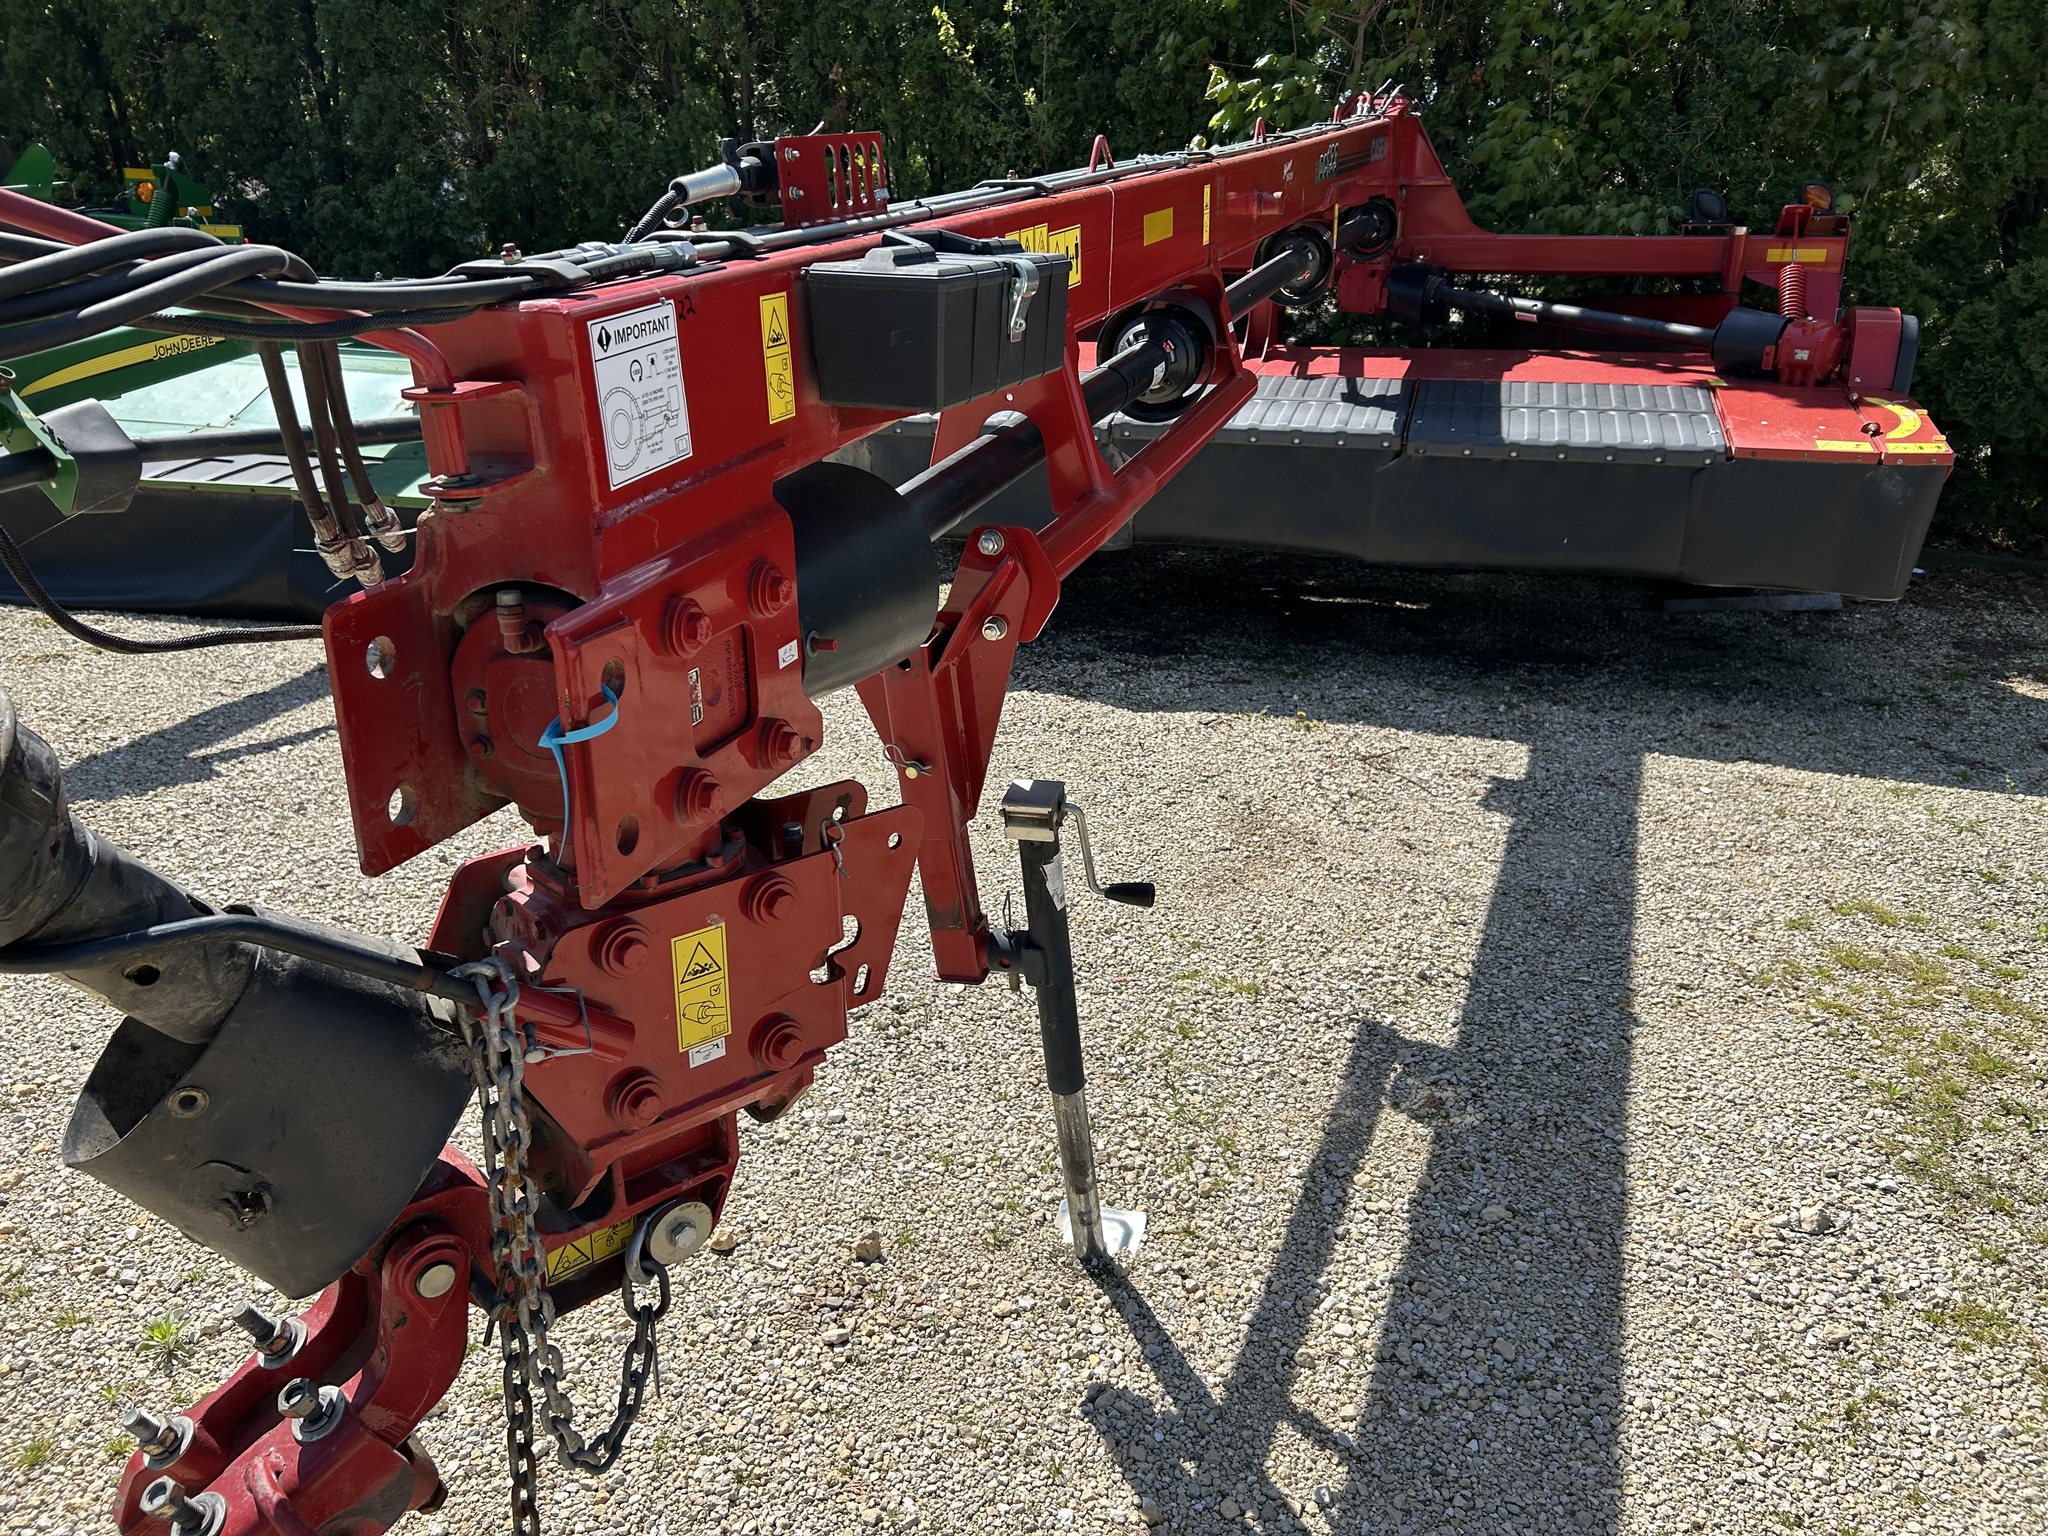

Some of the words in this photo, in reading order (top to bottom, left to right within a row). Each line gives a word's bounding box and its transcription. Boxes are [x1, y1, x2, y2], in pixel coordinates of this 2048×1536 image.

[677, 294, 697, 321] 22
[613, 315, 670, 345] IMPORTANT
[152, 342, 181, 359] JOHN
[181, 336, 214, 351] DEERE
